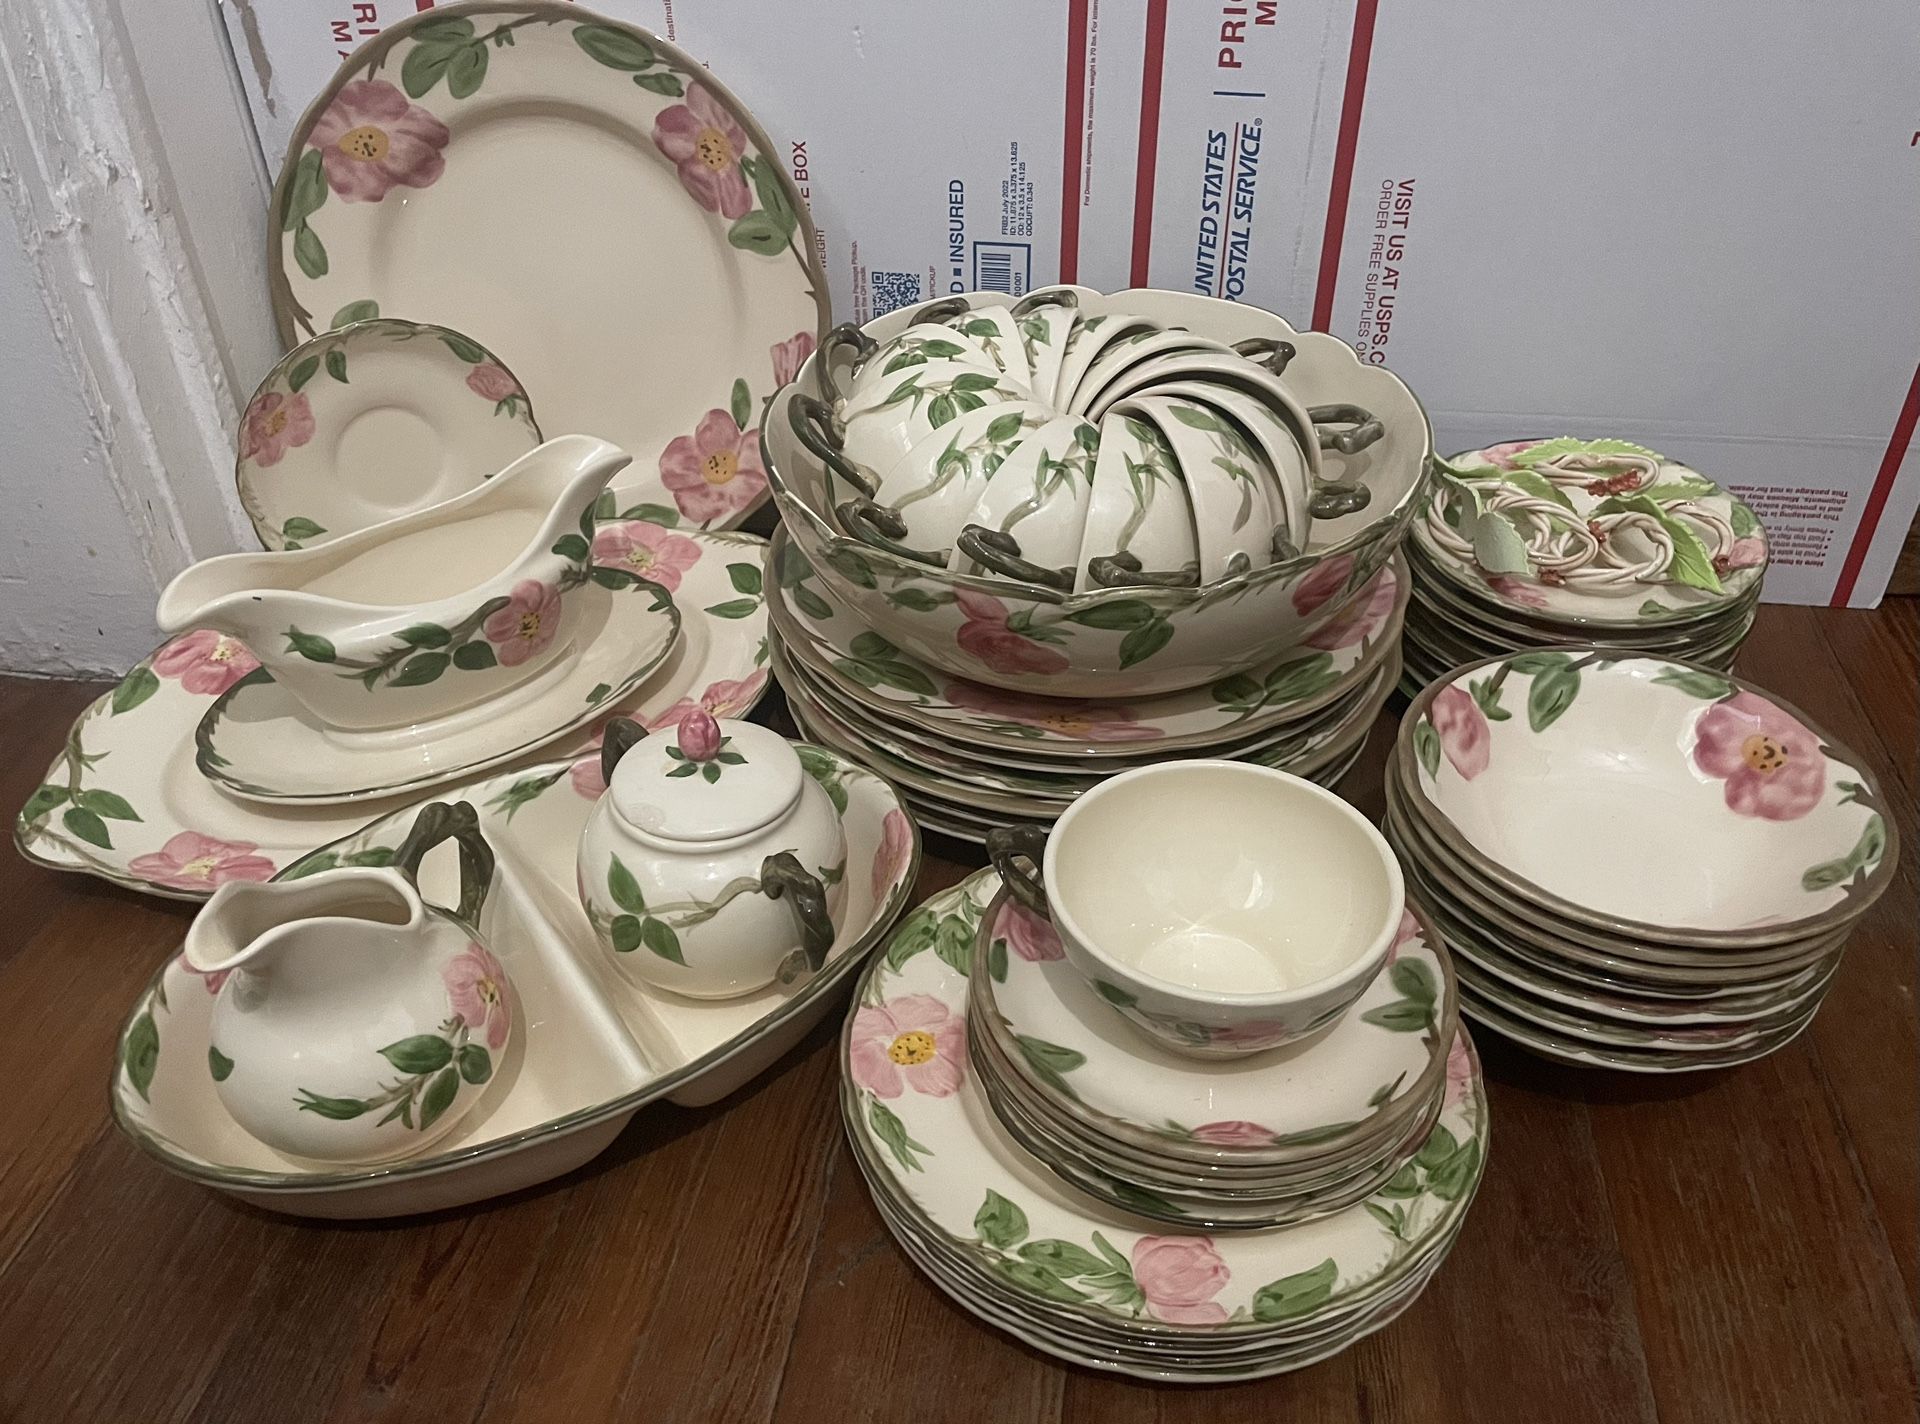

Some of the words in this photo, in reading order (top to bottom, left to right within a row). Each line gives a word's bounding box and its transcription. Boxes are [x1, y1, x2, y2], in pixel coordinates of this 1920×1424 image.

[1090, 48, 1096, 56] 70
[792, 141, 808, 181] BOX
[1202, 130, 1226, 214] STATES
[949, 180, 964, 262] INSURED
[1002, 199, 1010, 214] July
[1019, 212, 1025, 221] 12
[1375, 180, 1393, 229] ORDER
[1392, 179, 1415, 229] VISIT
[1195, 216, 1217, 296] UNITED
[1369, 235, 1384, 269] FREE
[1386, 235, 1405, 261] US
[1382, 267, 1399, 290] AT
[1358, 273, 1379, 337] SUPPLIES
[1795, 488, 1830, 496] package
[1780, 511, 1821, 519] packaging
